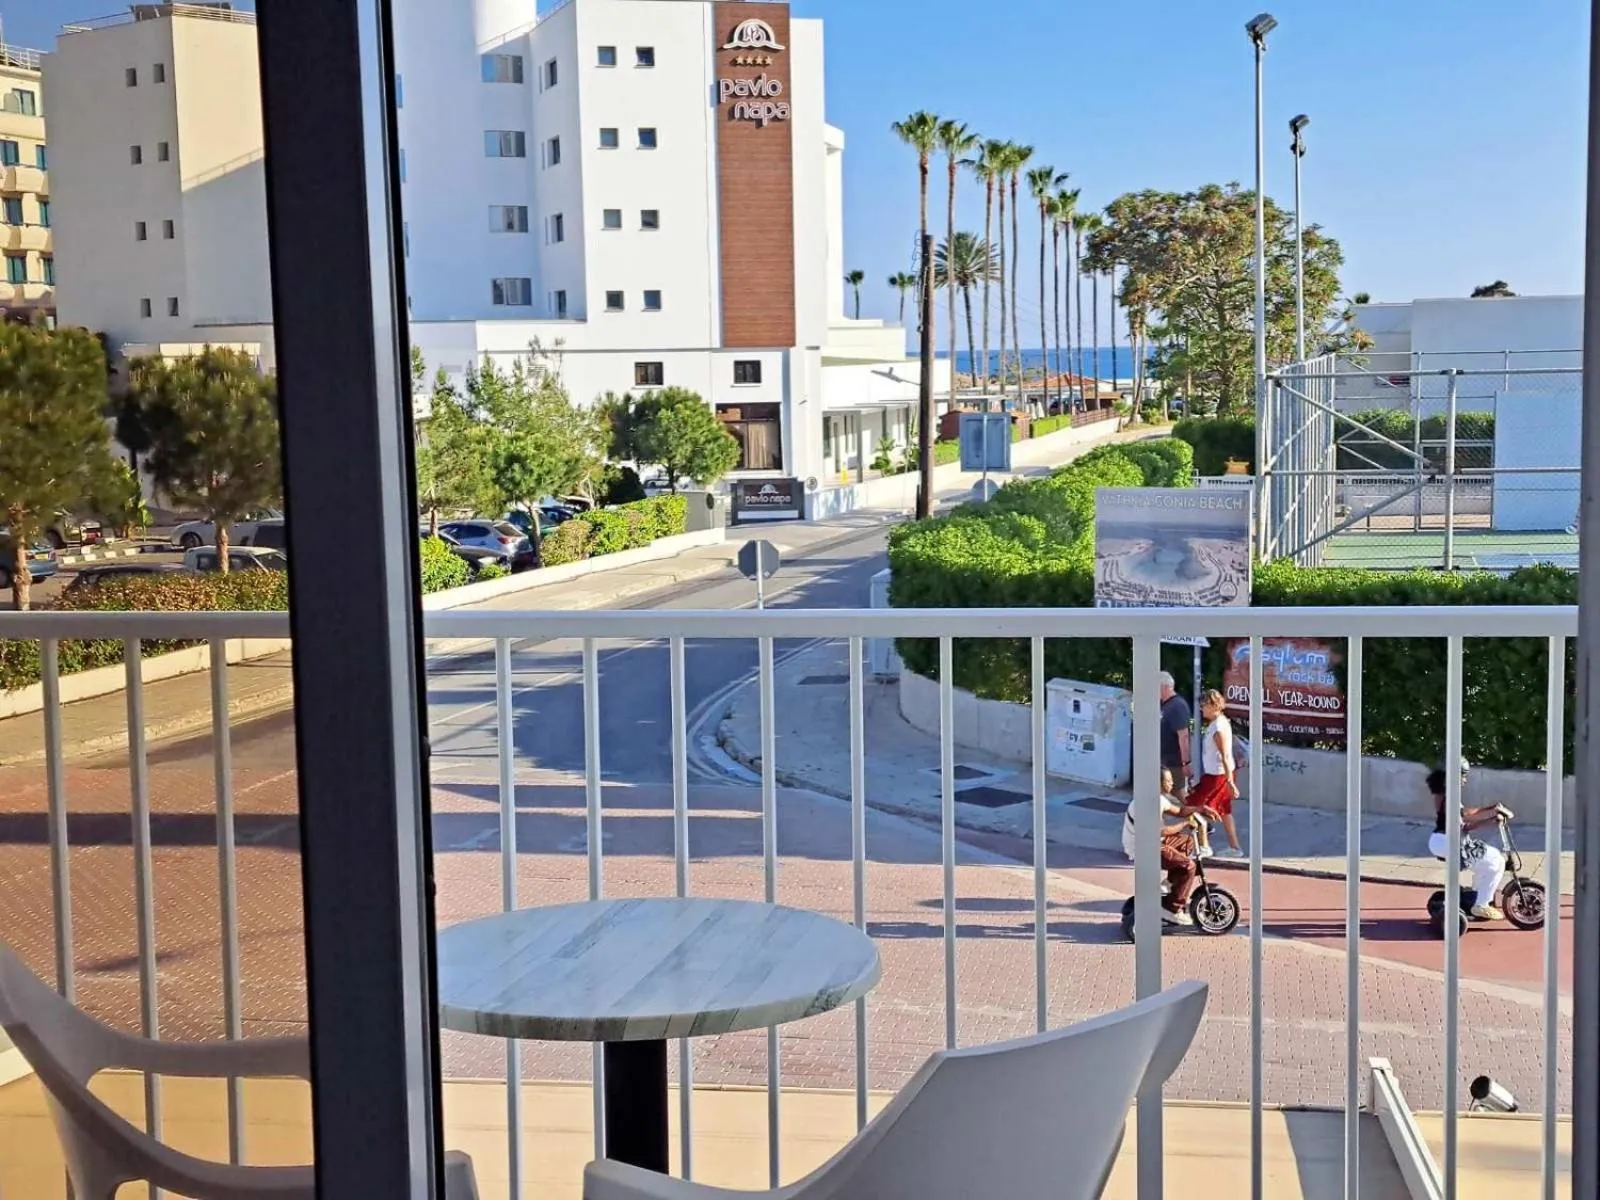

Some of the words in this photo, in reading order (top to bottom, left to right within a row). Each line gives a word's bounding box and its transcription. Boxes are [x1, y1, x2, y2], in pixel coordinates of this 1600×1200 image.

[719, 73, 783, 103] pavlo
[734, 101, 790, 126] napa
[1199, 496, 1243, 510] BEACH
[1278, 689, 1341, 710] YEAR-ROUND
